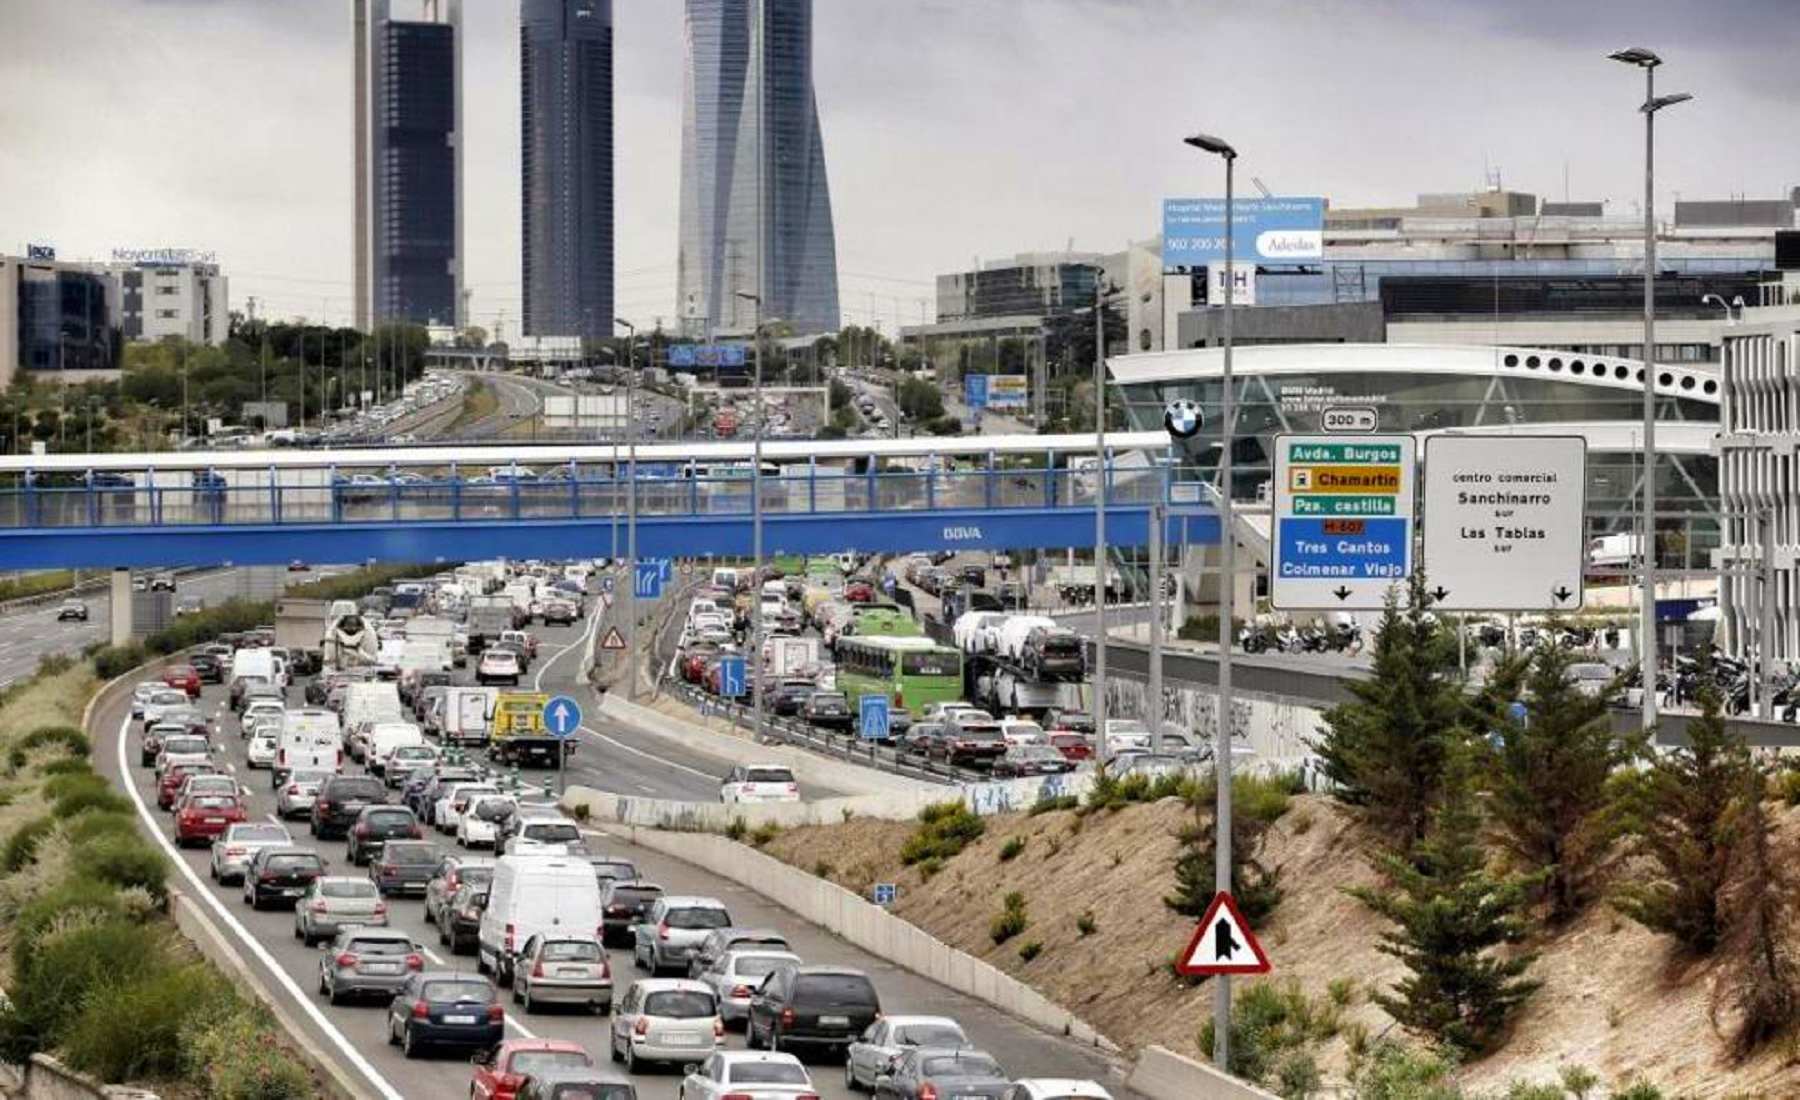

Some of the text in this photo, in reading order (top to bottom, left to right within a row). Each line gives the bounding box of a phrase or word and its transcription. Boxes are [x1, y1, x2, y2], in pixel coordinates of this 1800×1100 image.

[1328, 414, 1372, 426] 300 m
[1293, 447, 1398, 462] Avda. Burgos
[1453, 472, 1557, 483] centro comercial
[1458, 491, 1552, 505] Sanchinarro
[1335, 498, 1391, 513] castilla
[1461, 526, 1546, 539] Las Tablas
[1295, 540, 1391, 555] Tres Cantos
[1282, 562, 1403, 577] Colmenar Viejo
